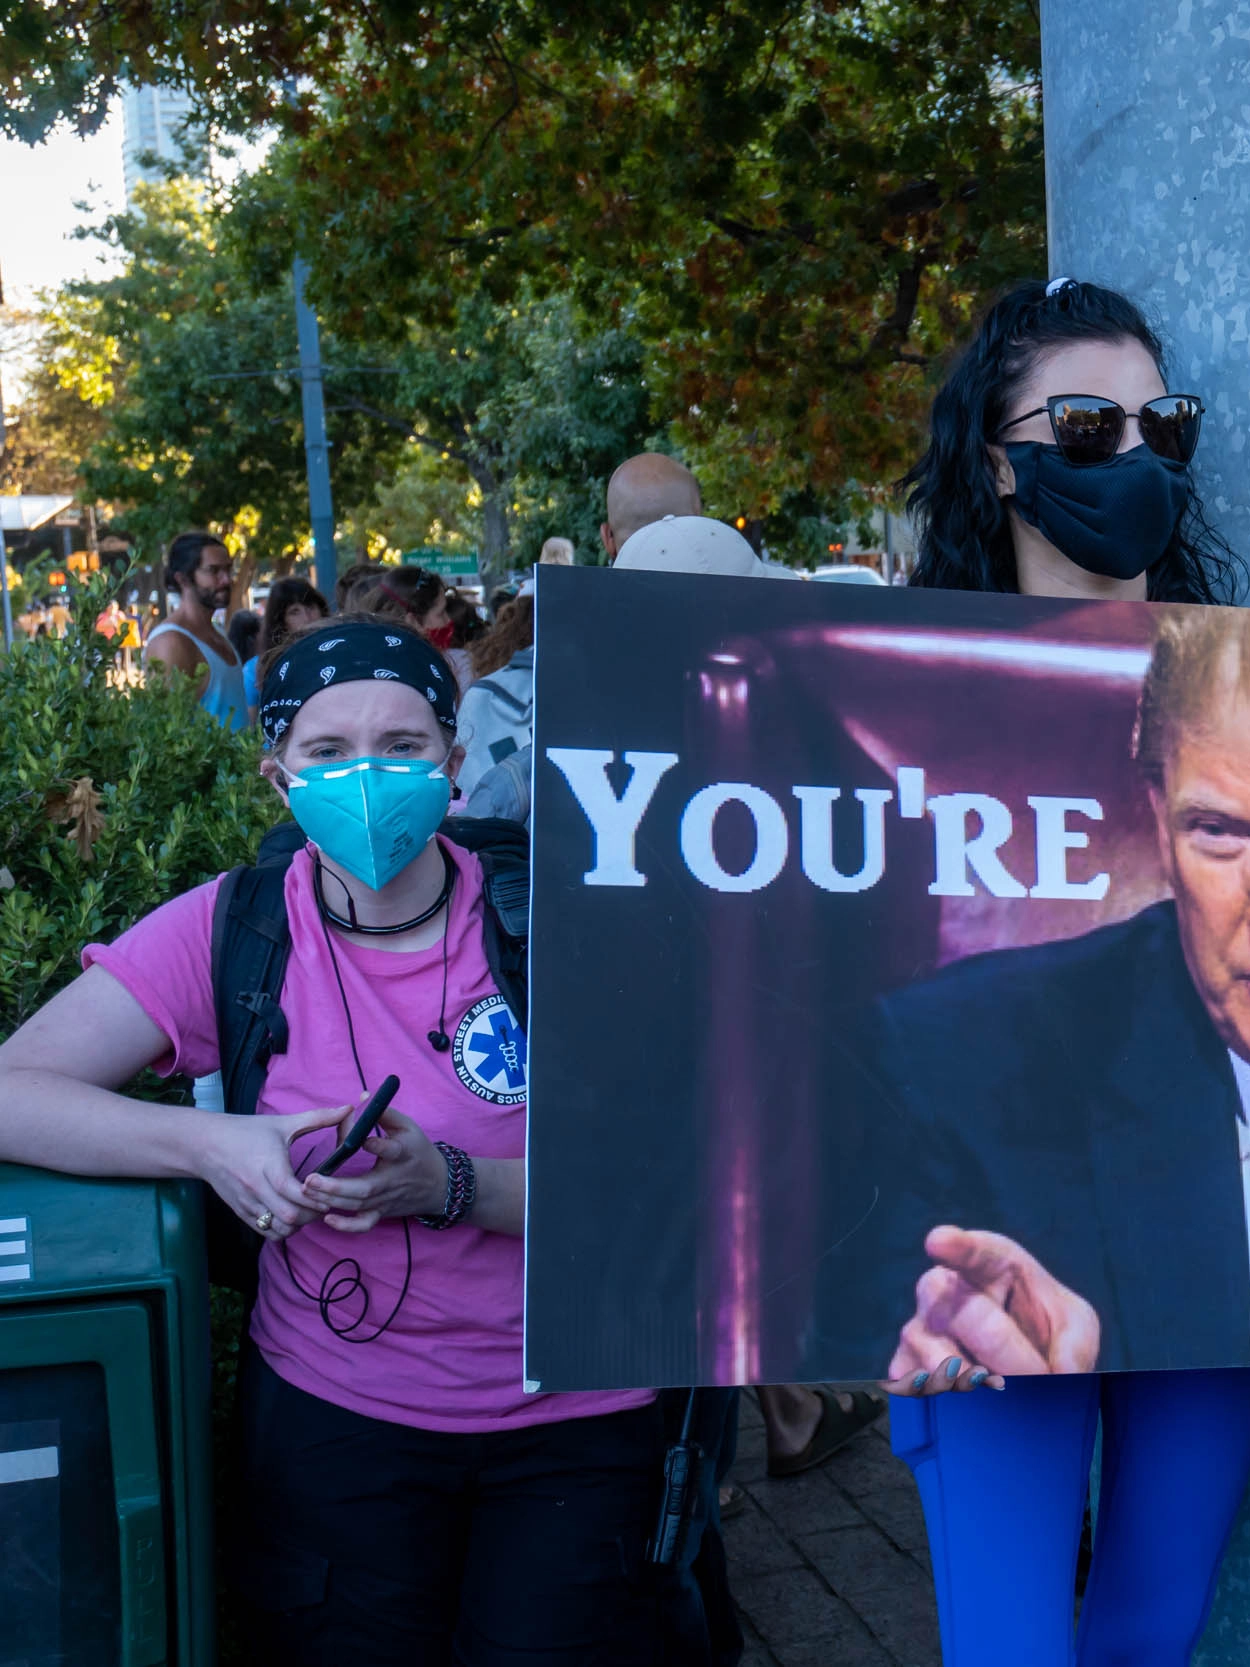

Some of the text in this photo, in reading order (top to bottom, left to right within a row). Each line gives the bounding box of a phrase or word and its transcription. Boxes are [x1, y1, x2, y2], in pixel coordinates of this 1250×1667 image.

[453, 1015, 473, 1062] STREET
[456, 1065, 495, 1100] AUSTIN
[497, 1092, 527, 1104] DICS
